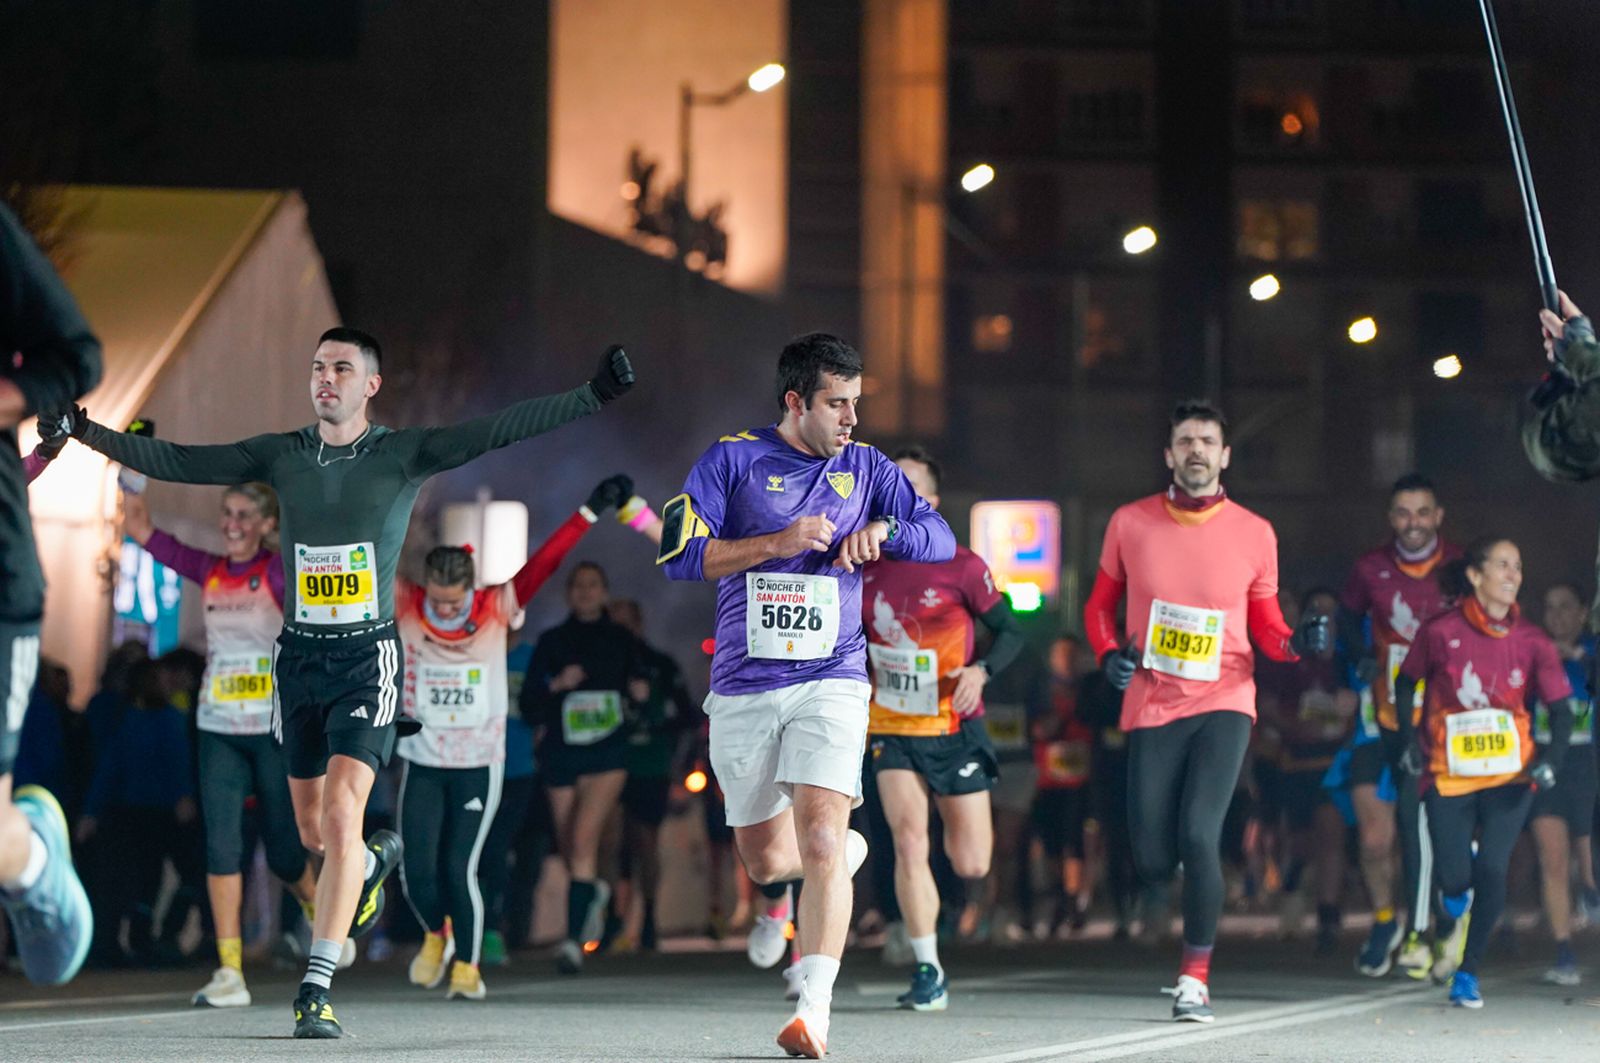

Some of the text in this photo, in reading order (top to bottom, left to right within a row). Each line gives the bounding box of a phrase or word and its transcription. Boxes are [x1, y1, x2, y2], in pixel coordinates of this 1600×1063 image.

[332, 555, 341, 563] DE
[314, 564, 343, 574] ANTÓN
[306, 574, 359, 598] 9079
[766, 583, 806, 593] NOCHE DE
[756, 593, 806, 604] SAN ANTÓN
[761, 604, 823, 632] 5628
[777, 631, 804, 639] MANOLO
[1159, 627, 1213, 656] 13937
[430, 688, 475, 705] 3226
[1463, 733, 1506, 752] 8919
